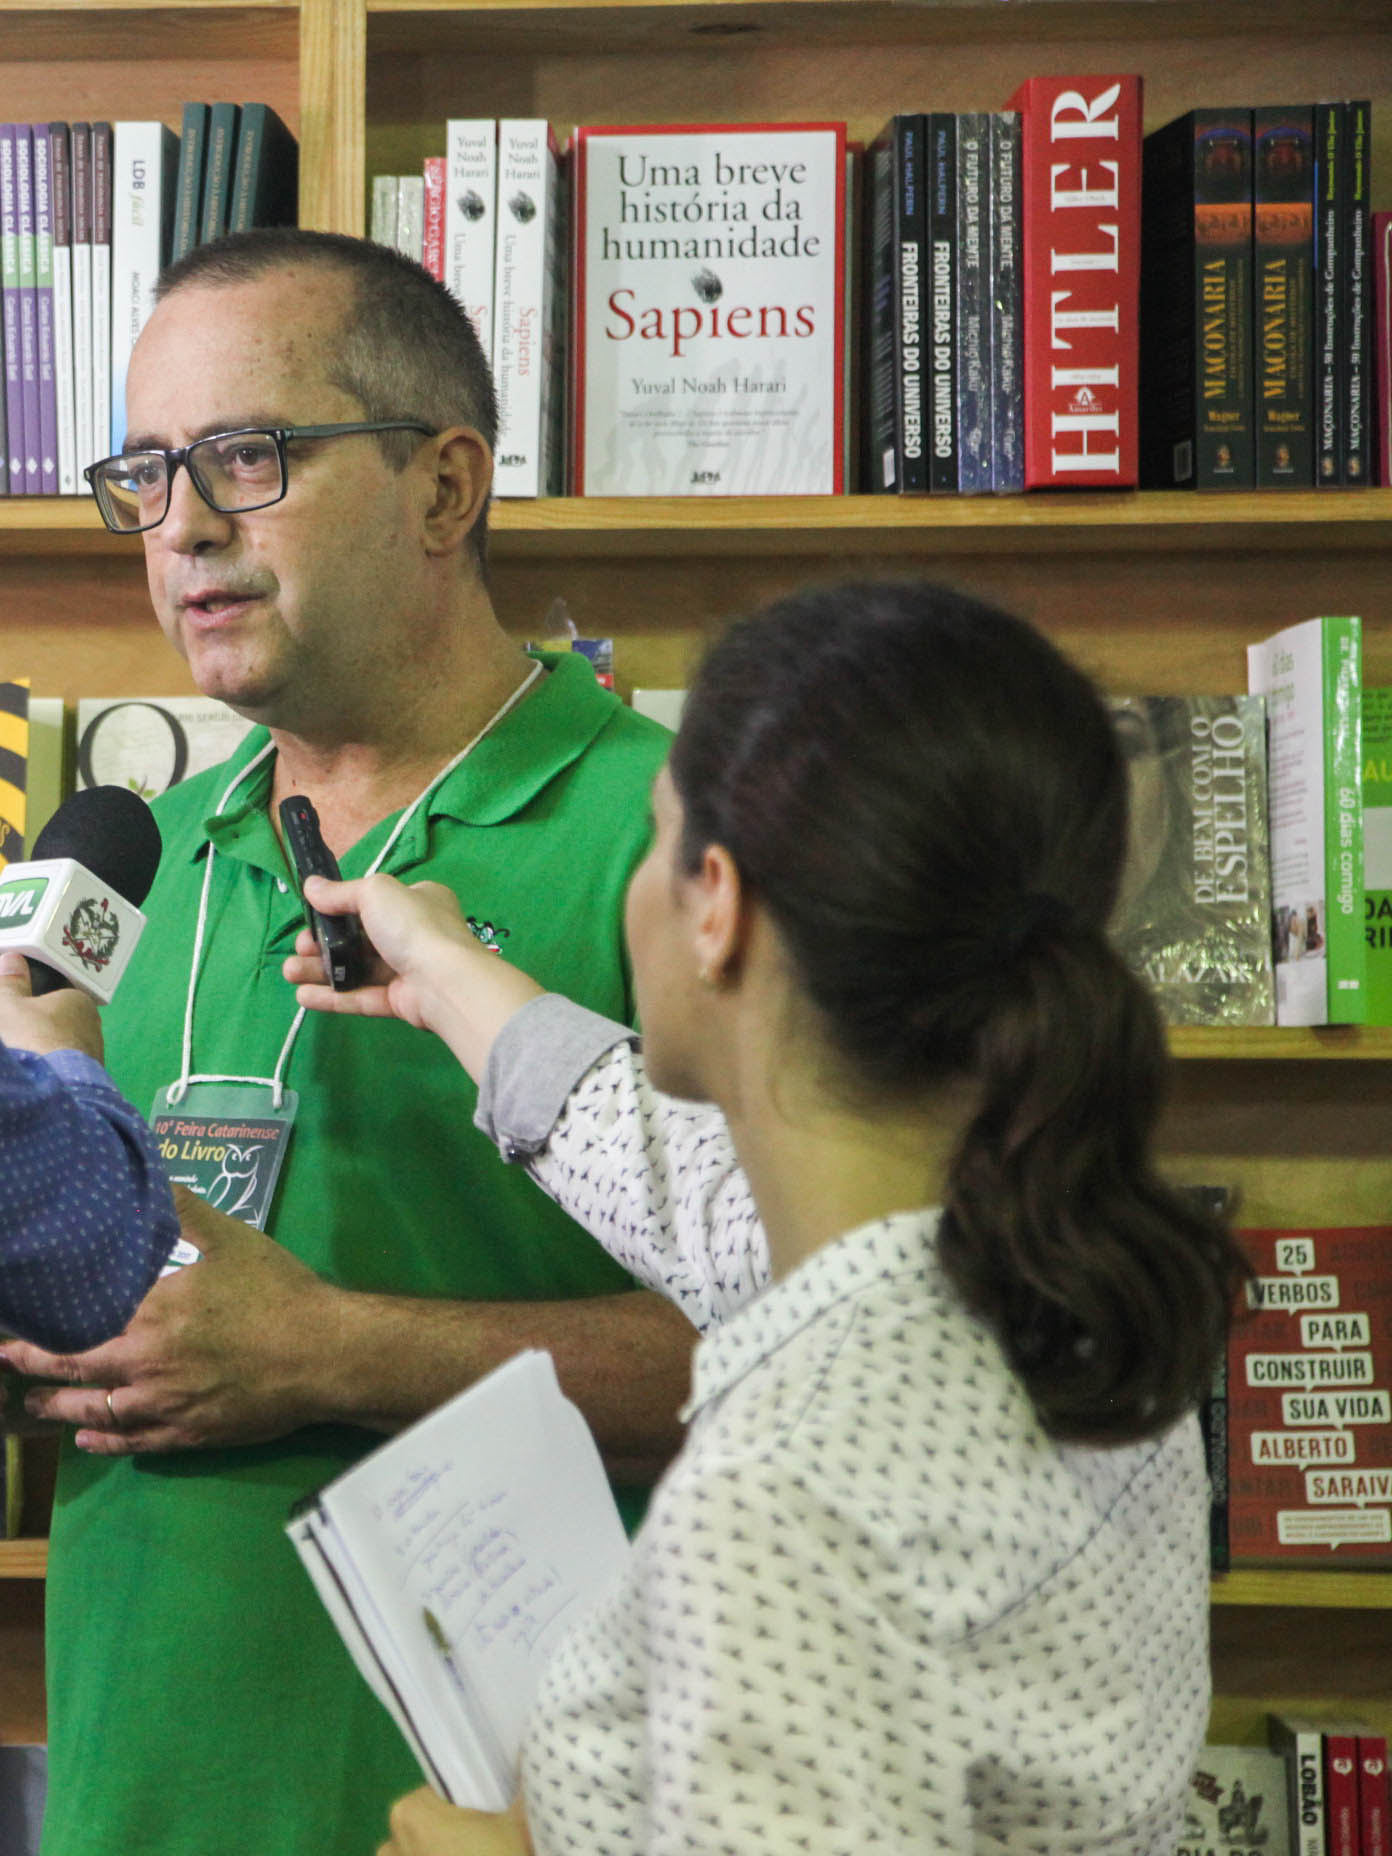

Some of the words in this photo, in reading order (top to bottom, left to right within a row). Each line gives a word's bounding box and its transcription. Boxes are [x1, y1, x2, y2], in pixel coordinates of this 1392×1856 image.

[131, 159, 146, 190] LDB
[617, 155, 701, 187] Uma
[715, 152, 807, 186] breve
[966, 153, 980, 203] FUTURO
[999, 152, 1013, 203] FUTURO
[620, 190, 748, 224] história
[762, 188, 803, 221] da
[967, 205, 979, 223] DA
[1000, 205, 1013, 223] DA
[504, 235, 517, 264] Uma
[602, 225, 821, 260] humanidade
[503, 266, 516, 297] breve
[901, 241, 920, 345] FRONTEIRAS
[933, 241, 952, 344] FRONTEIRAS
[1051, 83, 1121, 475] HITLER
[502, 300, 516, 344] história
[605, 288, 816, 358] Sapiens
[1204, 259, 1228, 399] MAÇONARIA
[1264, 259, 1288, 399] MAÇONARIA
[501, 346, 514, 362] da
[514, 306, 537, 377] Sapiens
[903, 347, 920, 370] DO
[934, 346, 951, 370] DO
[631, 377, 676, 395] Yuval
[682, 377, 727, 395] Noah
[733, 376, 787, 394] Harari
[903, 374, 921, 458] UNIVERSO
[934, 374, 952, 458] UNIVERSO
[1191, 715, 1211, 738] O
[1192, 744, 1213, 802] COM
[1211, 714, 1249, 904] ESPELHO
[1339, 787, 1355, 810] 60
[1193, 807, 1214, 861] BEM
[1339, 812, 1356, 848] dias
[1194, 870, 1214, 904] DE
[1337, 851, 1353, 915] comigo
[175, 1120, 208, 1137] Feira
[208, 1122, 281, 1140] Catarinense
[181, 1139, 226, 1162] Livro
[1282, 1244, 1308, 1266] 25
[1253, 1282, 1332, 1304] VERBOS
[1309, 1320, 1363, 1341] PARA
[1253, 1358, 1367, 1382] CONSTRUIR
[1289, 1399, 1330, 1420] SUA
[1335, 1397, 1384, 1419] VIDA
[1259, 1437, 1348, 1460] ALBERTO
[1313, 1475, 1392, 1498] SARAIV
